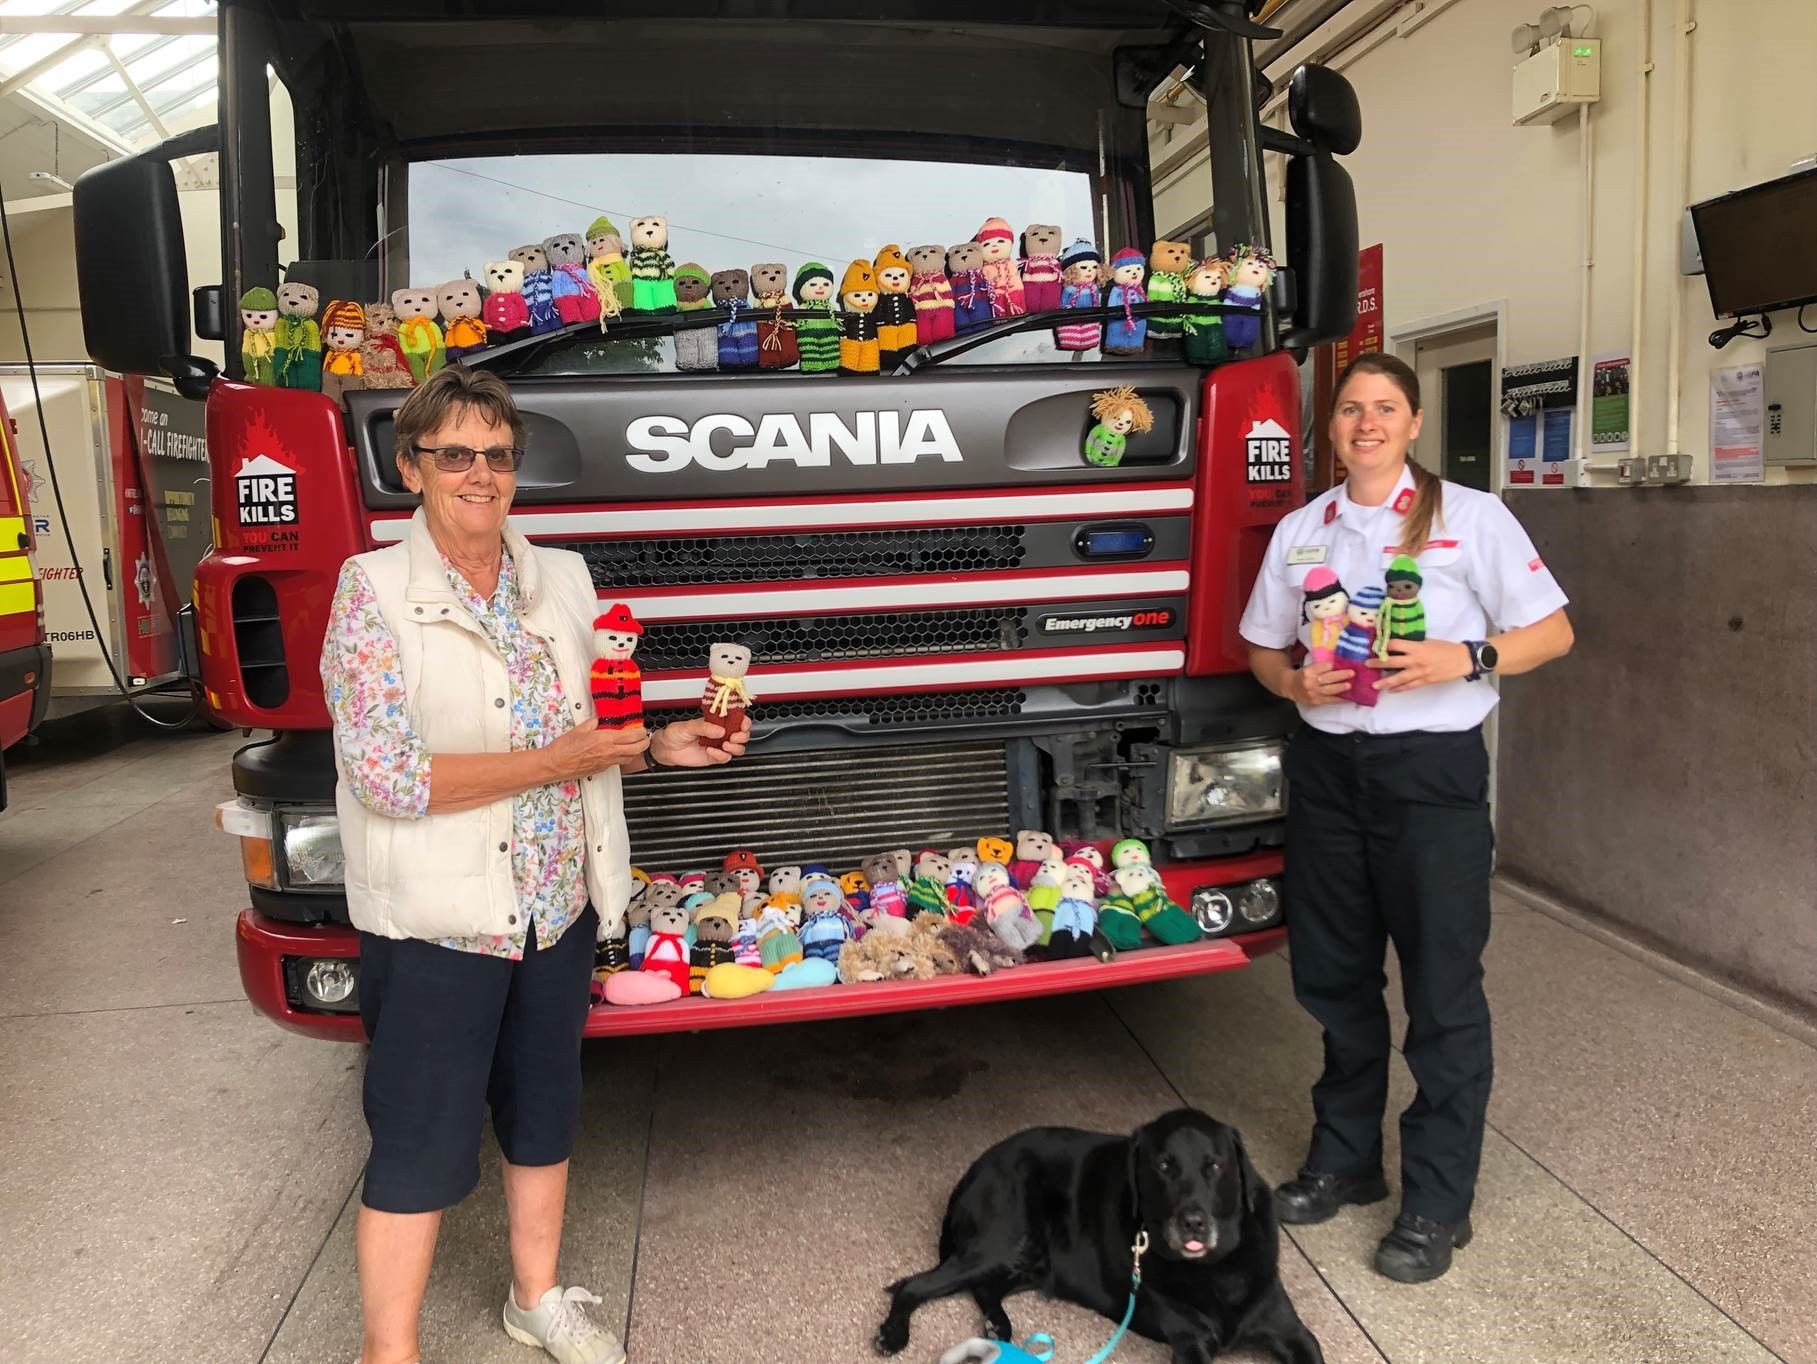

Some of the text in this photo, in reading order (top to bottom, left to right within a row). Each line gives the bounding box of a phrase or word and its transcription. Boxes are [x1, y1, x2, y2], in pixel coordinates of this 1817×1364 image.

[160, 413, 169, 426] an
[141, 427, 166, 456] -CALL
[625, 409, 964, 473] SCANIA
[1247, 440, 1290, 462] FIRE
[1248, 465, 1291, 480] KILLS
[238, 477, 294, 503] FIRE
[240, 505, 295, 523] KILLS
[243, 531, 298, 543] YOU CAN
[243, 543, 299, 553] PREVENT IT
[1045, 611, 1169, 632] Emergency one
